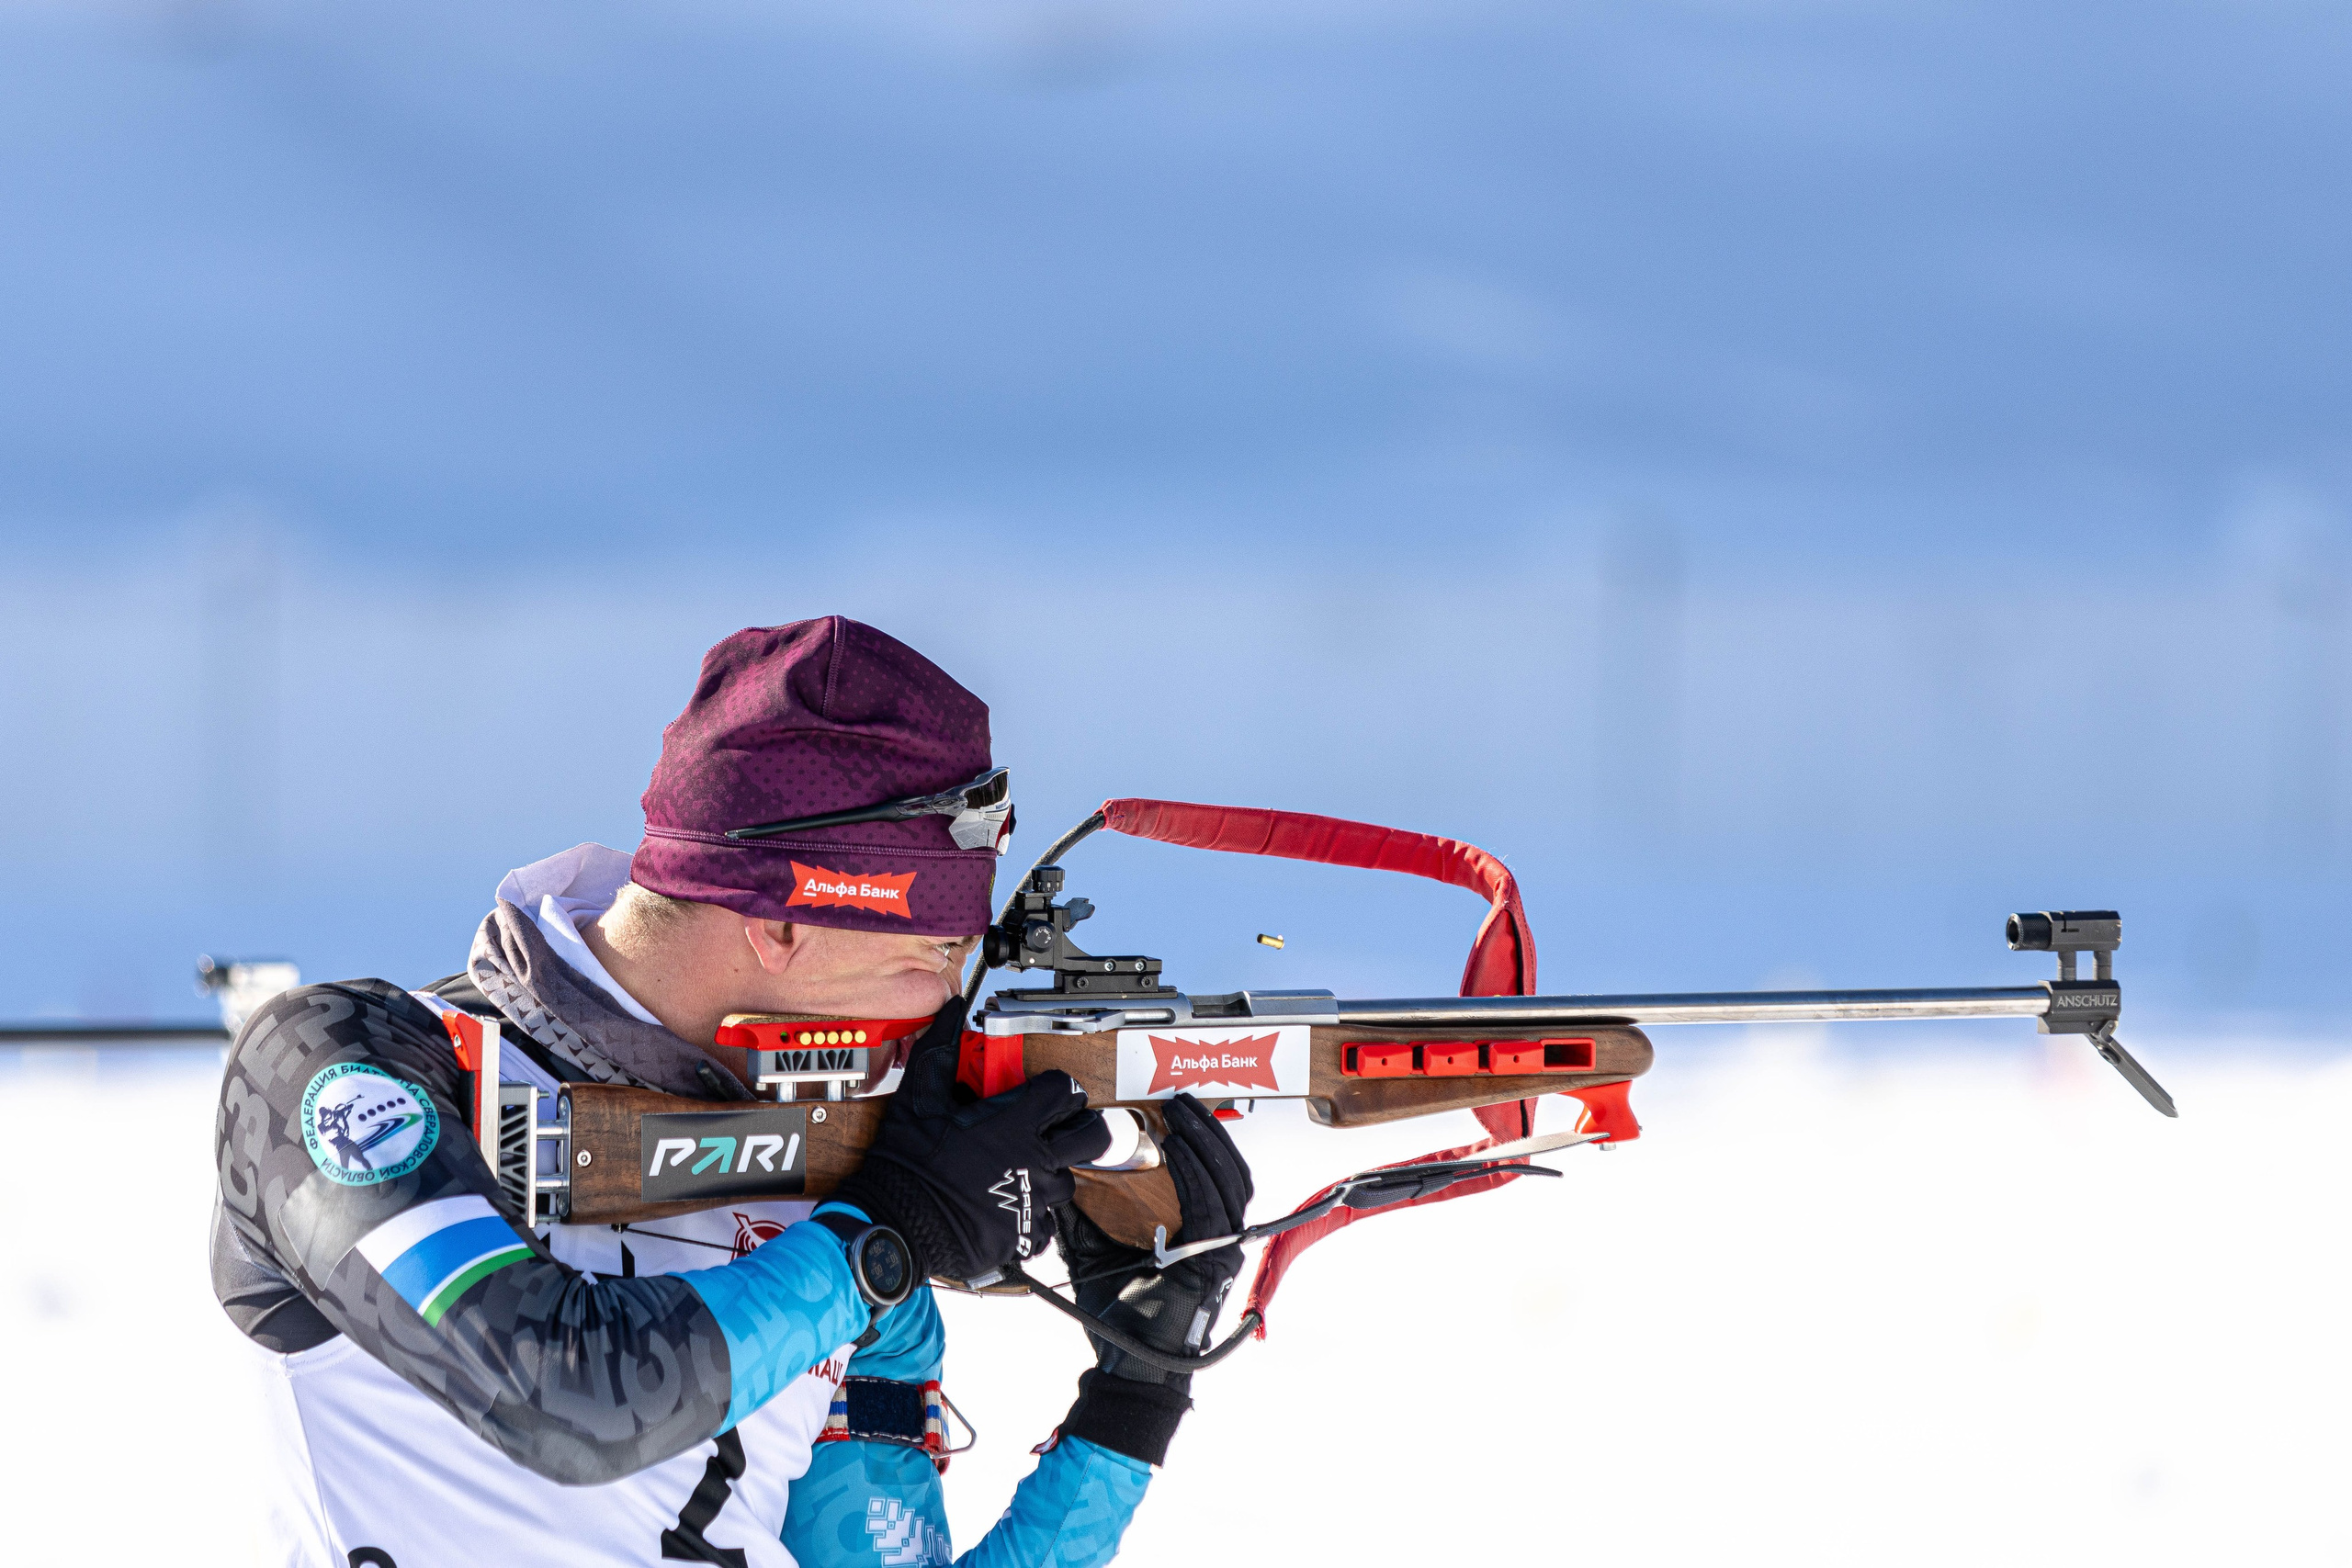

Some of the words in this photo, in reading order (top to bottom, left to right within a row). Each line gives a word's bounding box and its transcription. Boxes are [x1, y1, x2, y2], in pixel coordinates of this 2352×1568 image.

[803, 878, 857, 897] Альфа
[860, 883, 899, 899] Банк
[2057, 994, 2119, 1008] ANSCHUTZ
[1170, 1055, 1219, 1075] Альфа
[1221, 1054, 1258, 1068] Банк
[303, 1068, 338, 1150] ФЕДЕРАЦИЯ
[379, 1098, 437, 1180] СВЕРДЛОВСКОЙ
[649, 1133, 800, 1177] PARI
[321, 1158, 376, 1183] ОБЛАСТИ
[1016, 1168, 1031, 1234] RACE
